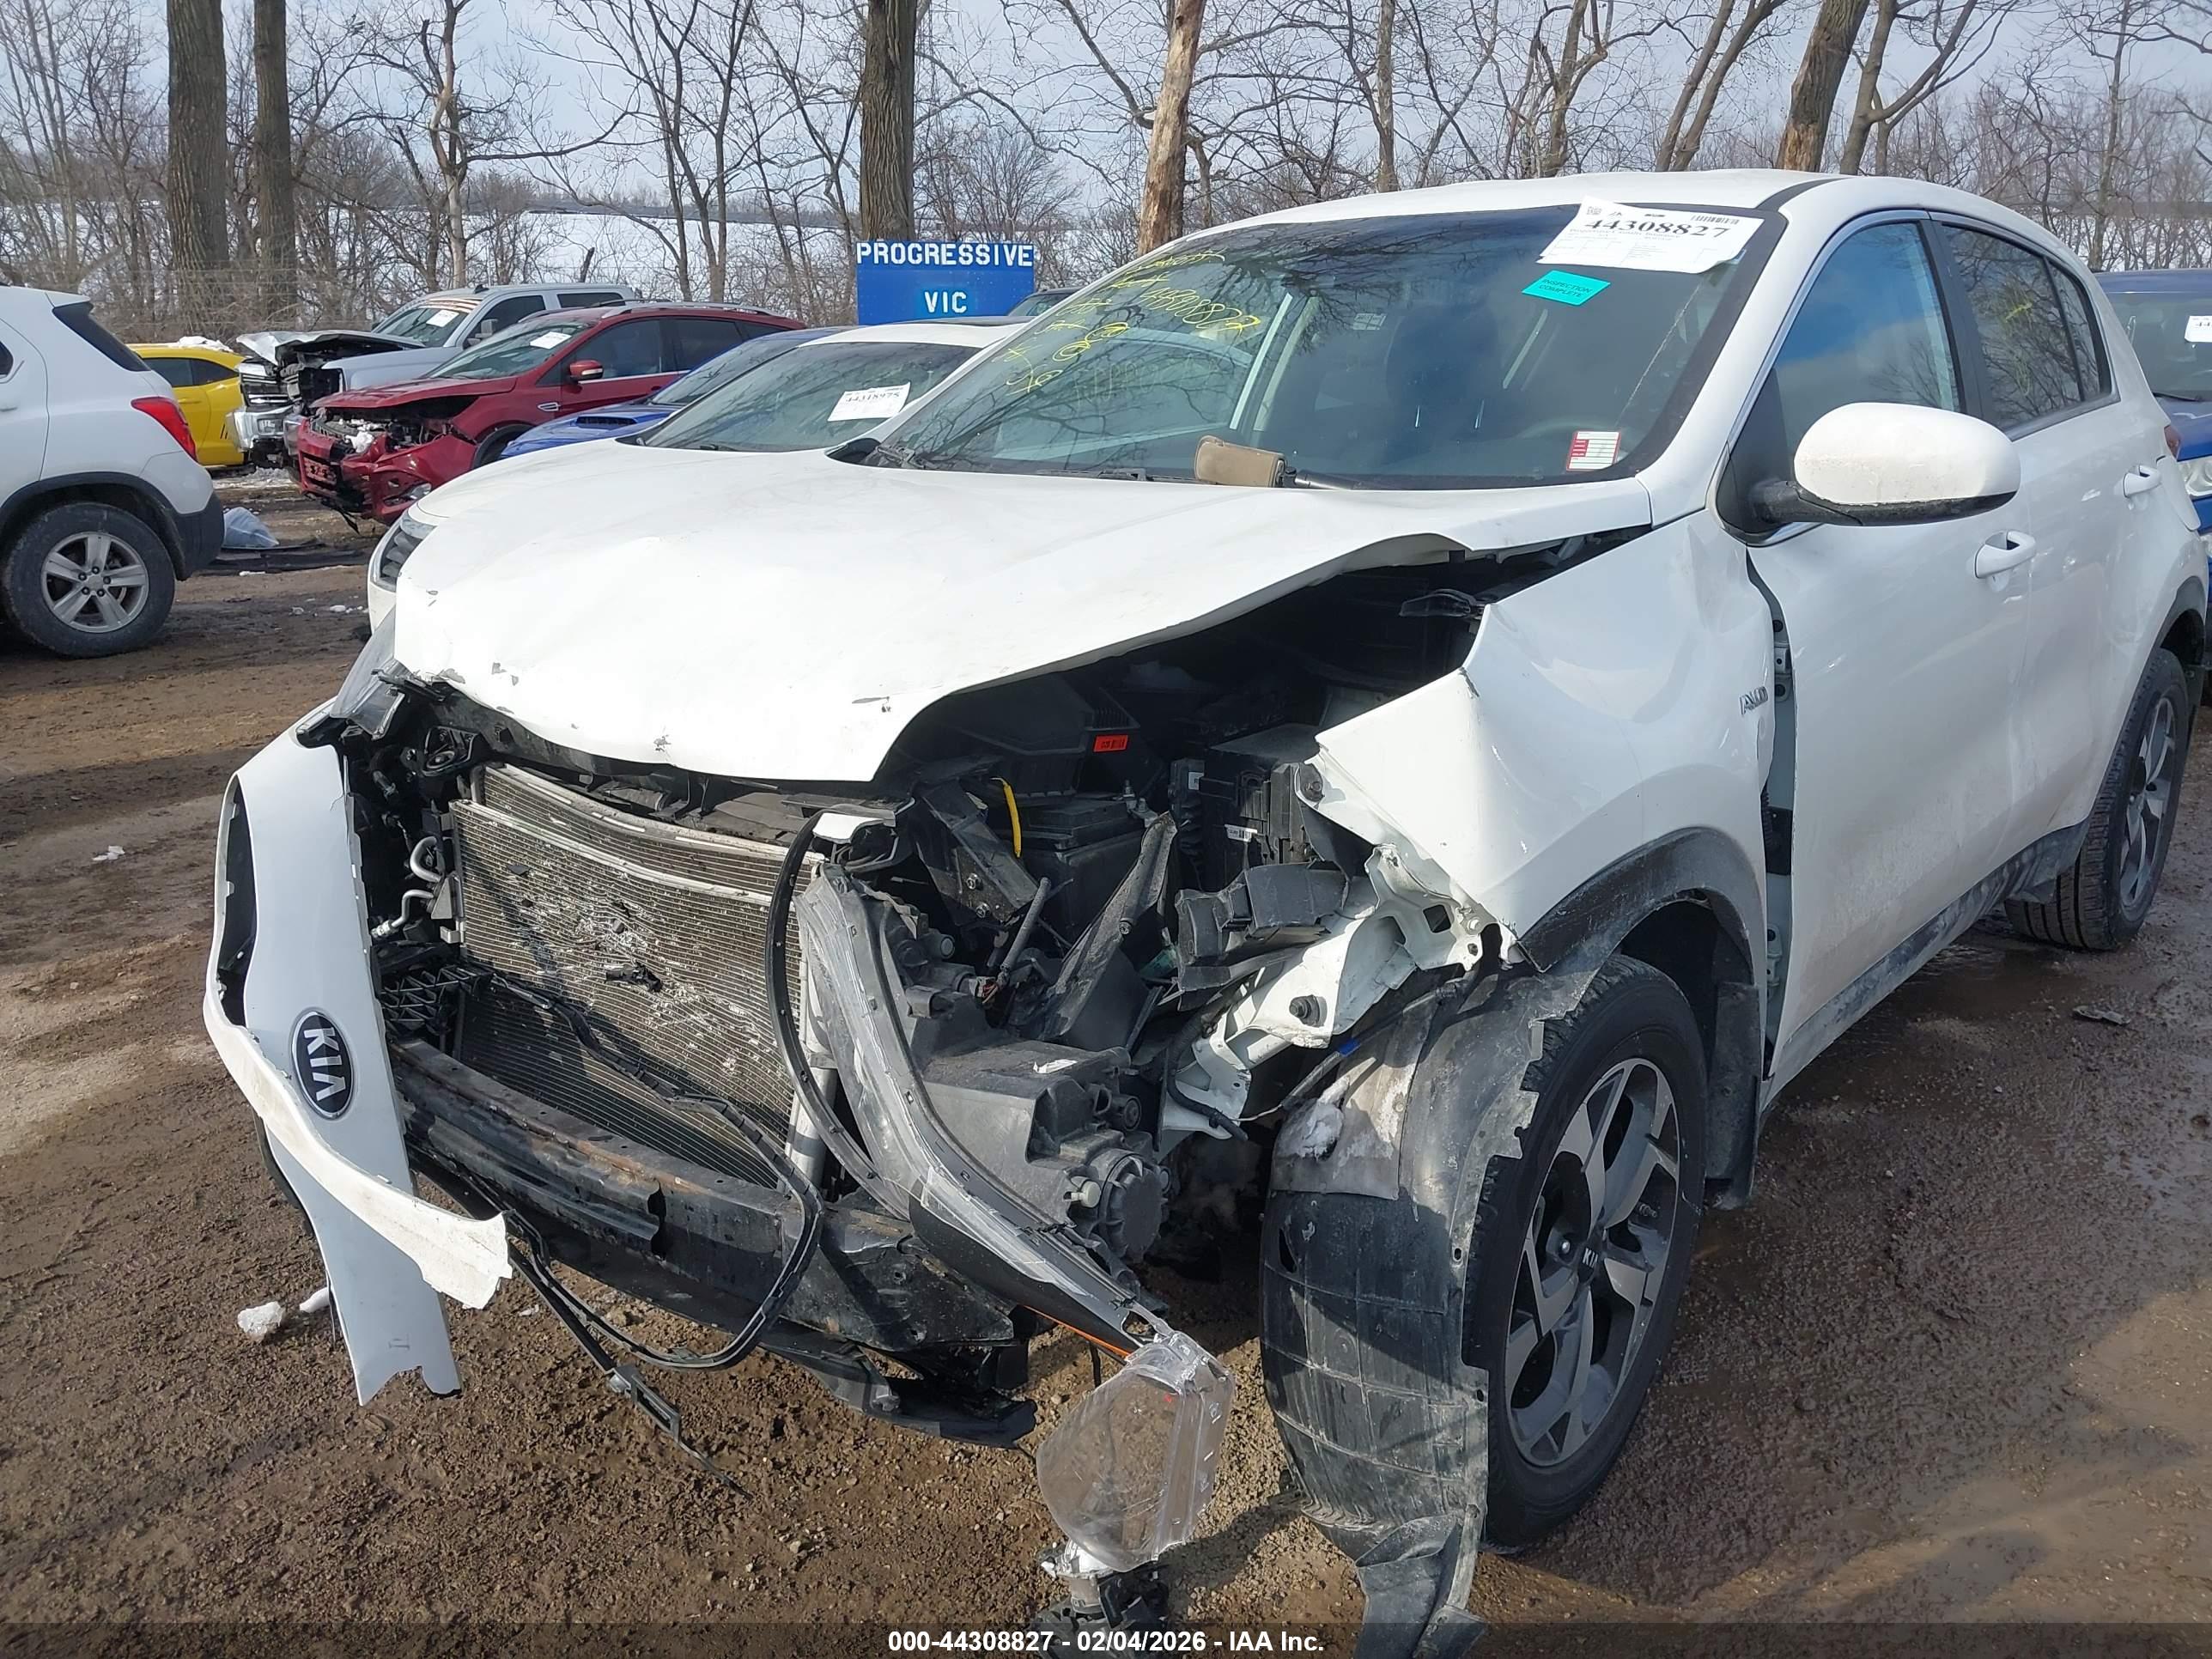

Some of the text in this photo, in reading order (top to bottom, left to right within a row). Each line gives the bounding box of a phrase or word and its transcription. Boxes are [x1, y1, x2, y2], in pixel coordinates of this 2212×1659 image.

[1584, 219, 1730, 238] 44308827
[856, 242, 1034, 267] PROGRESSIVE
[1538, 284, 1584, 297] COMPLETE
[1541, 279, 1593, 294] INSPECTION
[924, 291, 968, 313] VIC
[303, 1027, 346, 1101] KIA
